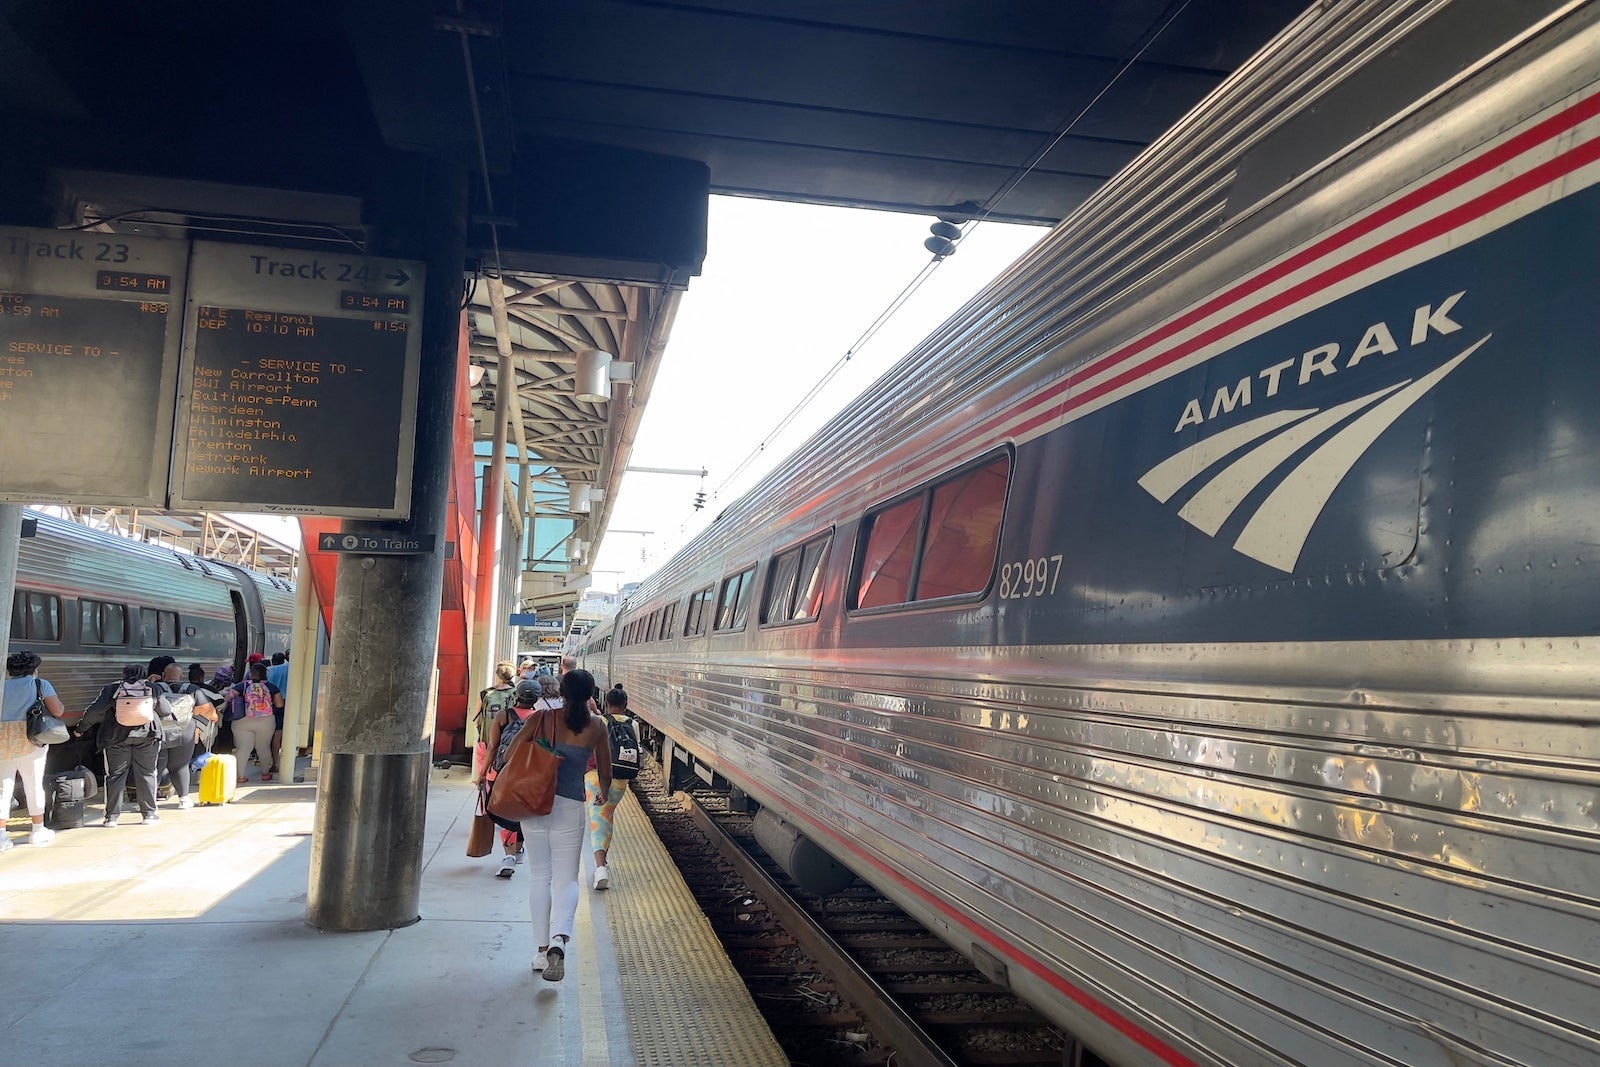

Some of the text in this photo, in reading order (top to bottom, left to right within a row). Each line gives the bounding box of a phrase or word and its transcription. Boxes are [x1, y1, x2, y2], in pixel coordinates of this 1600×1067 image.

[7, 236, 129, 263] Track 23
[250, 256, 369, 283] Track 24
[103, 275, 166, 290] 9:54 AM
[40, 307, 59, 318] AM
[246, 322, 288, 335] 10:10
[296, 327, 315, 337] AM
[373, 321, 406, 332] #154
[8, 342, 73, 355] SERVICE
[83, 346, 101, 357] TO
[259, 359, 320, 373] SERVICE
[329, 363, 346, 374] TO
[1175, 290, 1467, 433] AMTRAK
[195, 366, 319, 384] New Carrollton
[194, 378, 292, 393] BWI Airport
[192, 390, 318, 408] Baltimore-Penn
[191, 402, 264, 416] Aberdeen
[190, 415, 281, 429] Wilmington
[189, 427, 297, 442] Philadelphia
[189, 438, 252, 451] Trenton
[187, 451, 267, 464] Metropark
[186, 463, 311, 478] Newark Airport
[362, 538, 419, 549] To Trains
[1000, 554, 1063, 600] 82997
